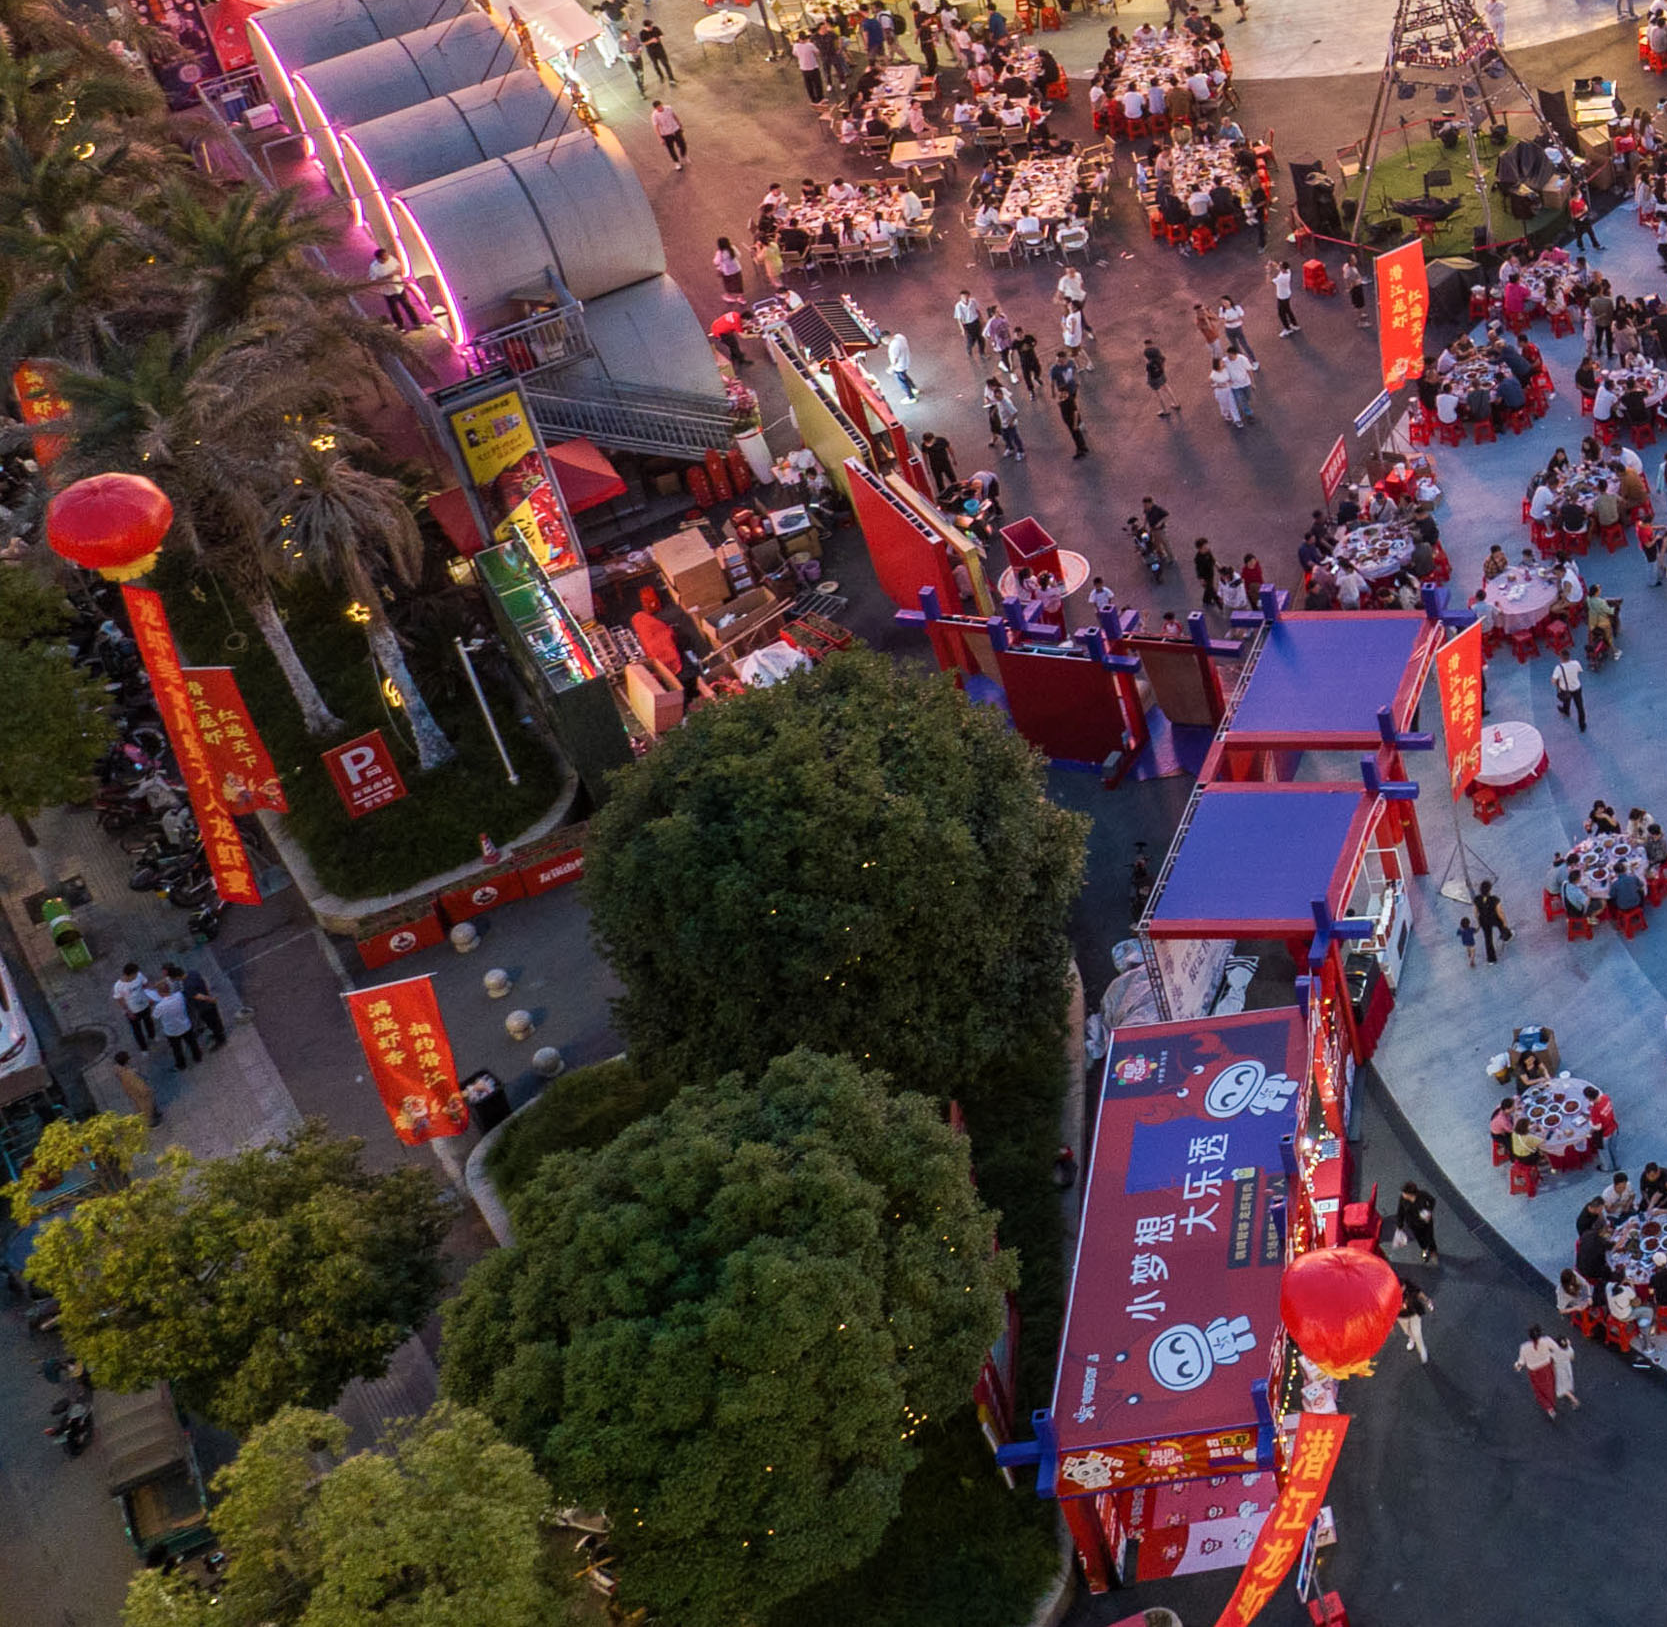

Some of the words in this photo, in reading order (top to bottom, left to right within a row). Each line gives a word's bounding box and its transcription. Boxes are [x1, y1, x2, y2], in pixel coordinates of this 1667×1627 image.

[340, 746, 375, 785] P
[1180, 1133, 1230, 1236] 大乐透
[1126, 1213, 1176, 1321] 小梦想
[1236, 1430, 1336, 1625] 潜江龙虾
